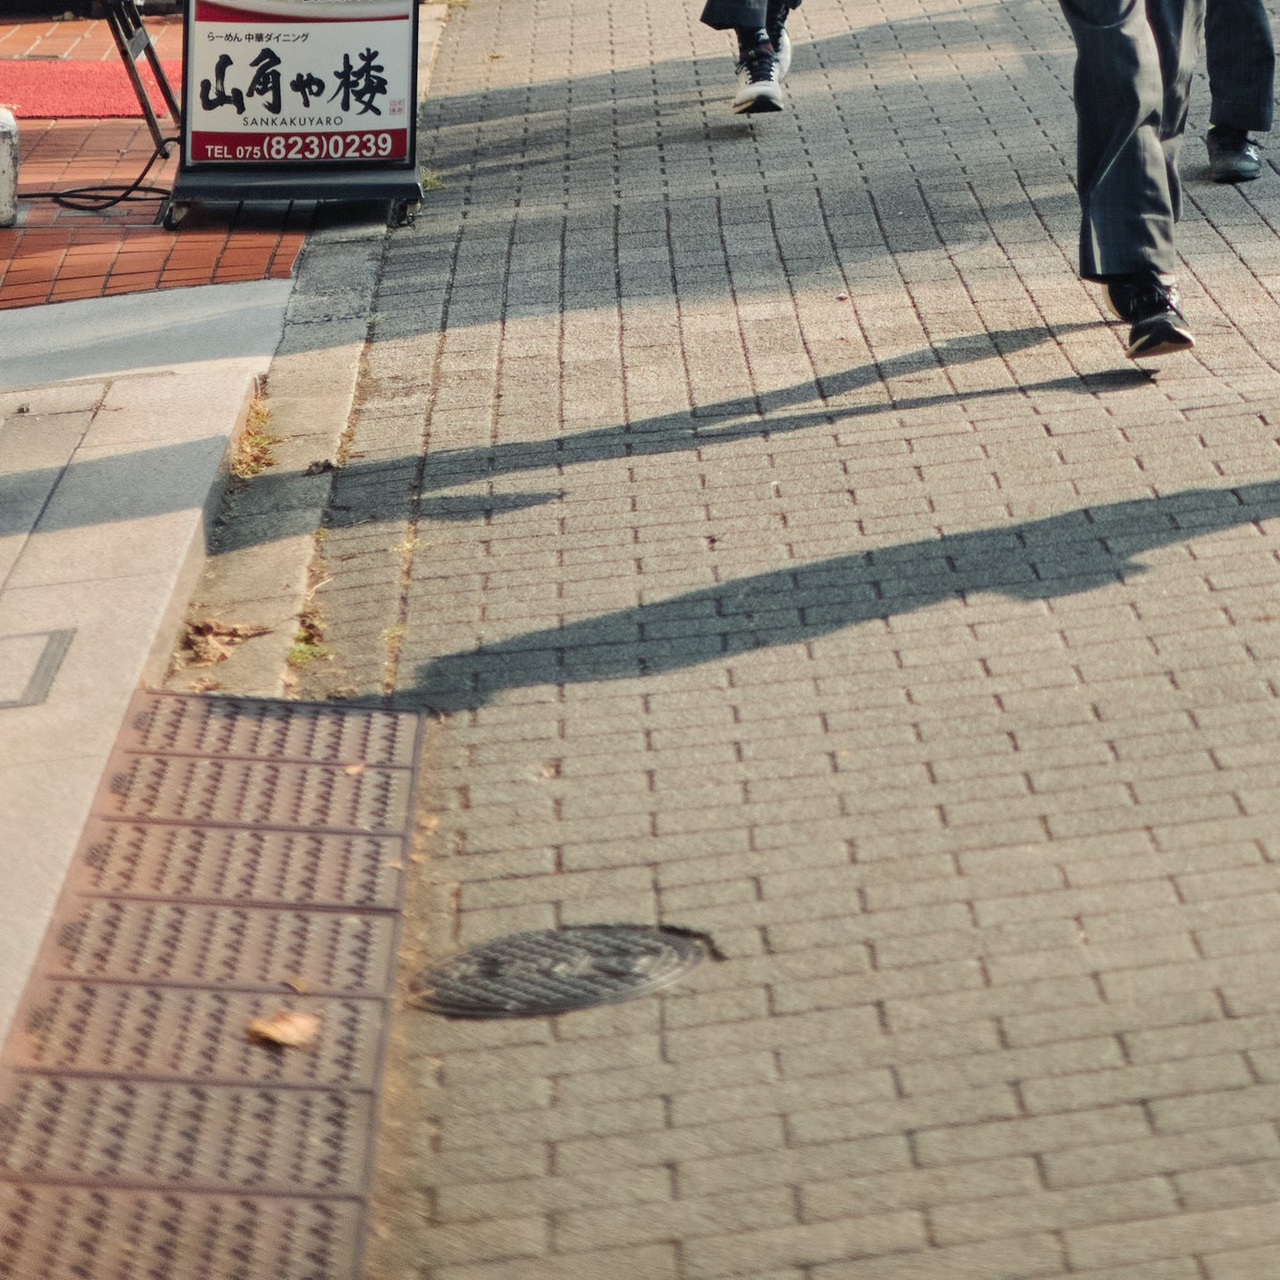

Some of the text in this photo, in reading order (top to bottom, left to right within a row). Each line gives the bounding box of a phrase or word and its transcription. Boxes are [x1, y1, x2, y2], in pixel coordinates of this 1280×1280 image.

[207, 31, 310, 43] らーめん 中華ダイニング
[200, 47, 388, 116] 山角や楼
[242, 115, 344, 127] SANKAKUYARO
[205, 144, 233, 159] TEL
